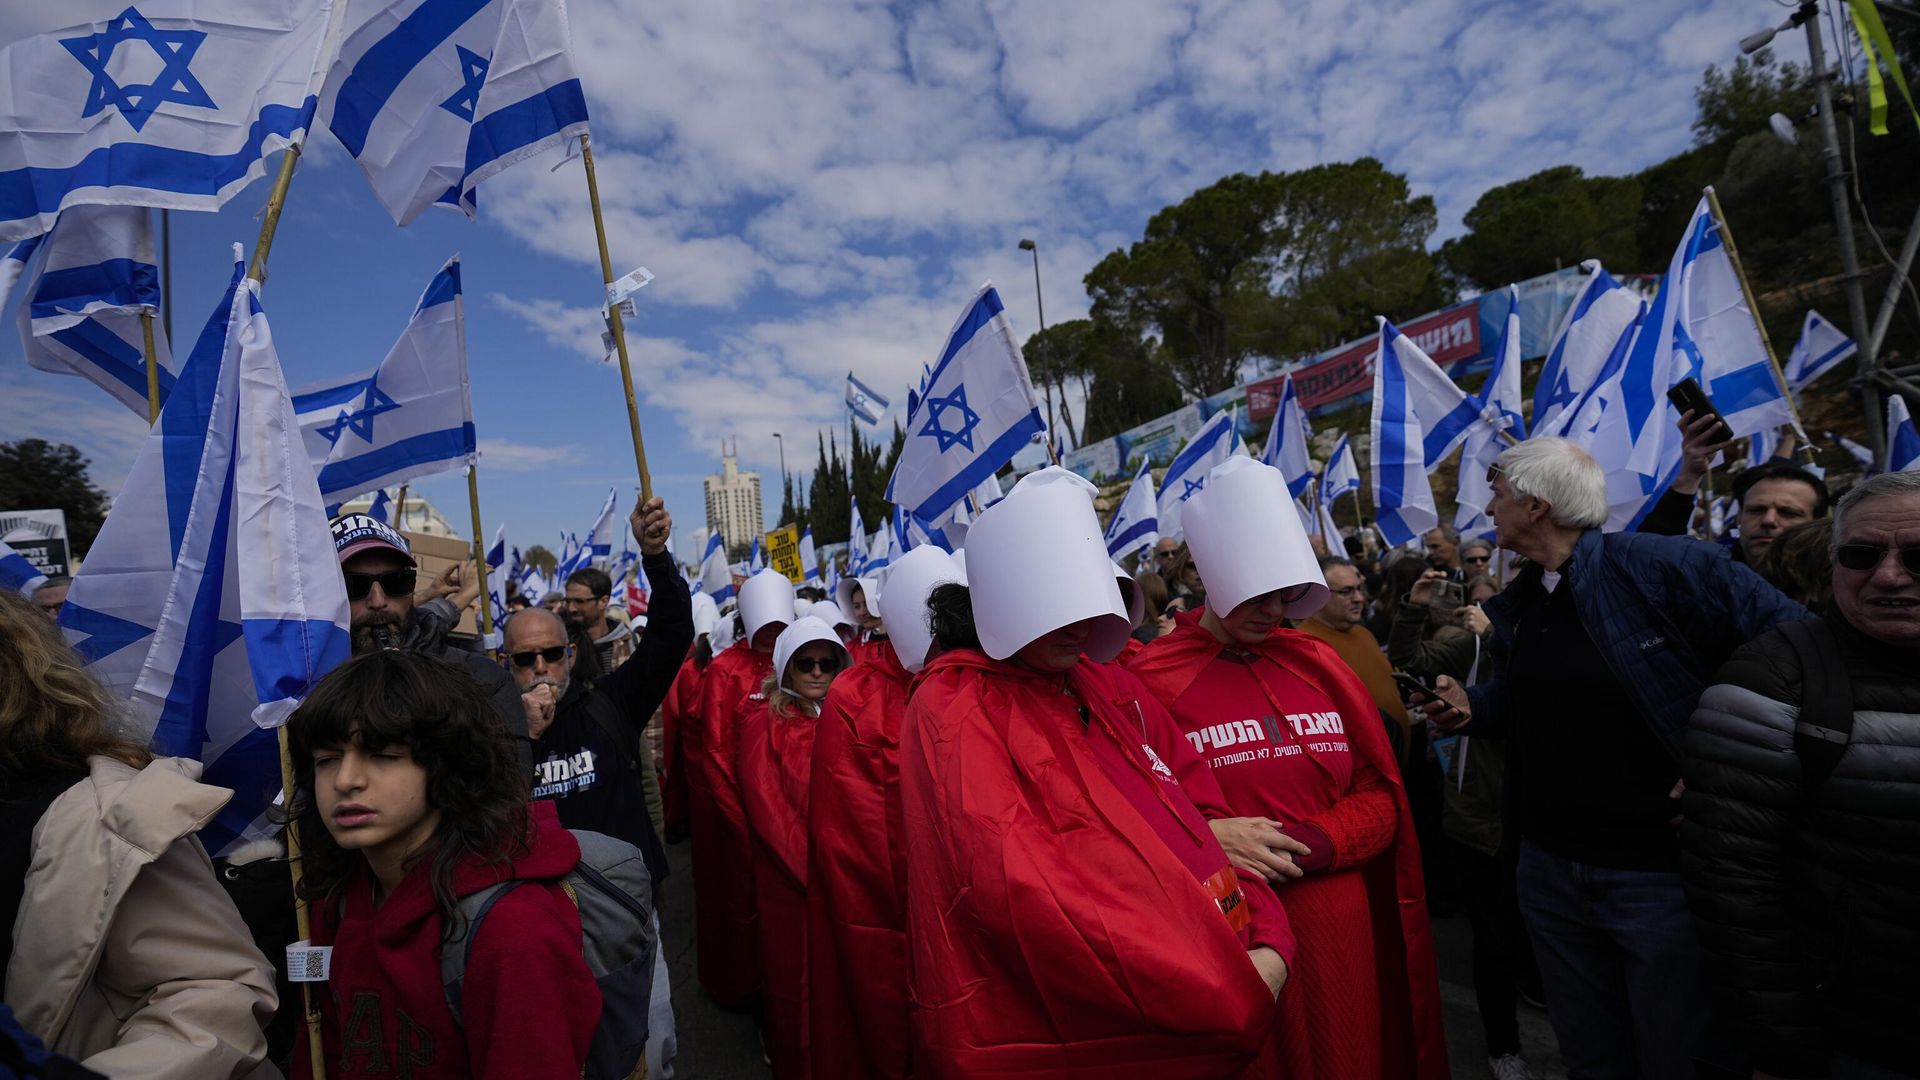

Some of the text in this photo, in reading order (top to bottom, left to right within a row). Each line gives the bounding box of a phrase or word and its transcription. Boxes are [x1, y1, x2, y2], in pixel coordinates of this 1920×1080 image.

[1214, 750, 1256, 768] במשמרת
[1257, 747, 1270, 758] לא
[1273, 745, 1303, 758] הנשים,
[334, 990, 435, 1080] AP
